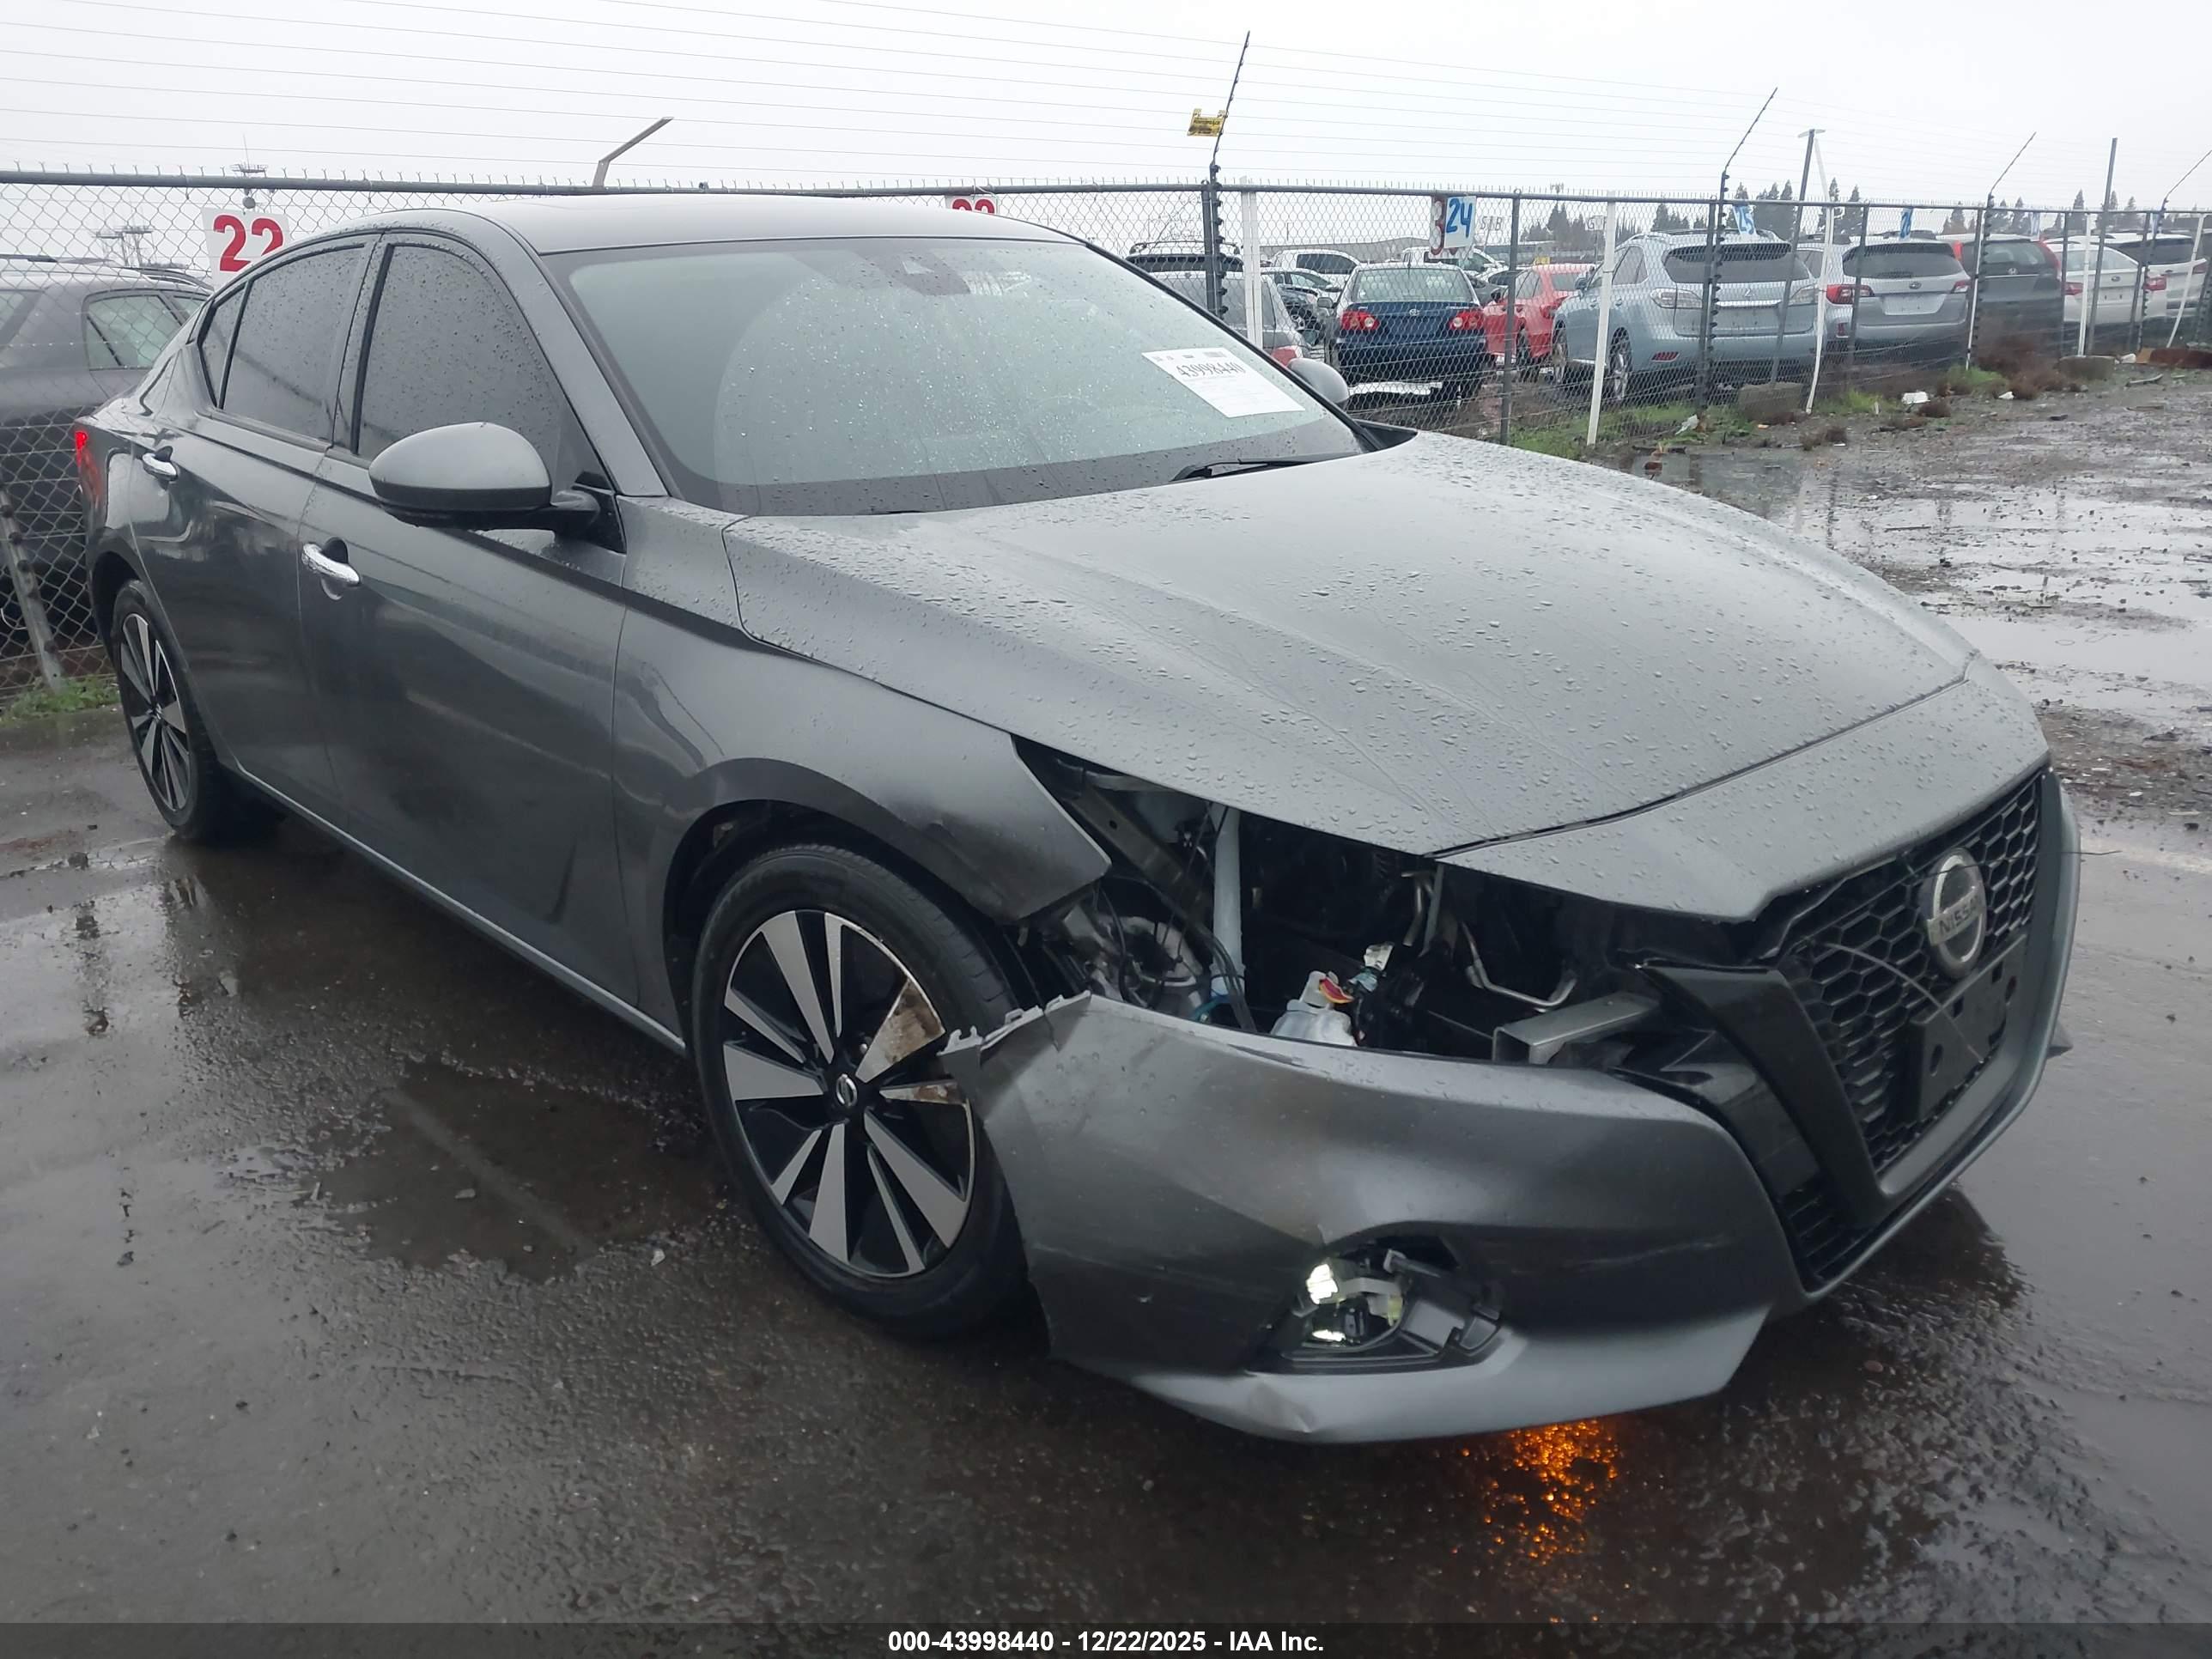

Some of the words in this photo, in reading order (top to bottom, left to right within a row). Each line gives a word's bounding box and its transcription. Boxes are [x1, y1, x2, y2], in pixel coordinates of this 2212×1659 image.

[1446, 198, 1473, 238] 24
[213, 214, 284, 272] 22
[1176, 361, 1247, 377] 43998440
